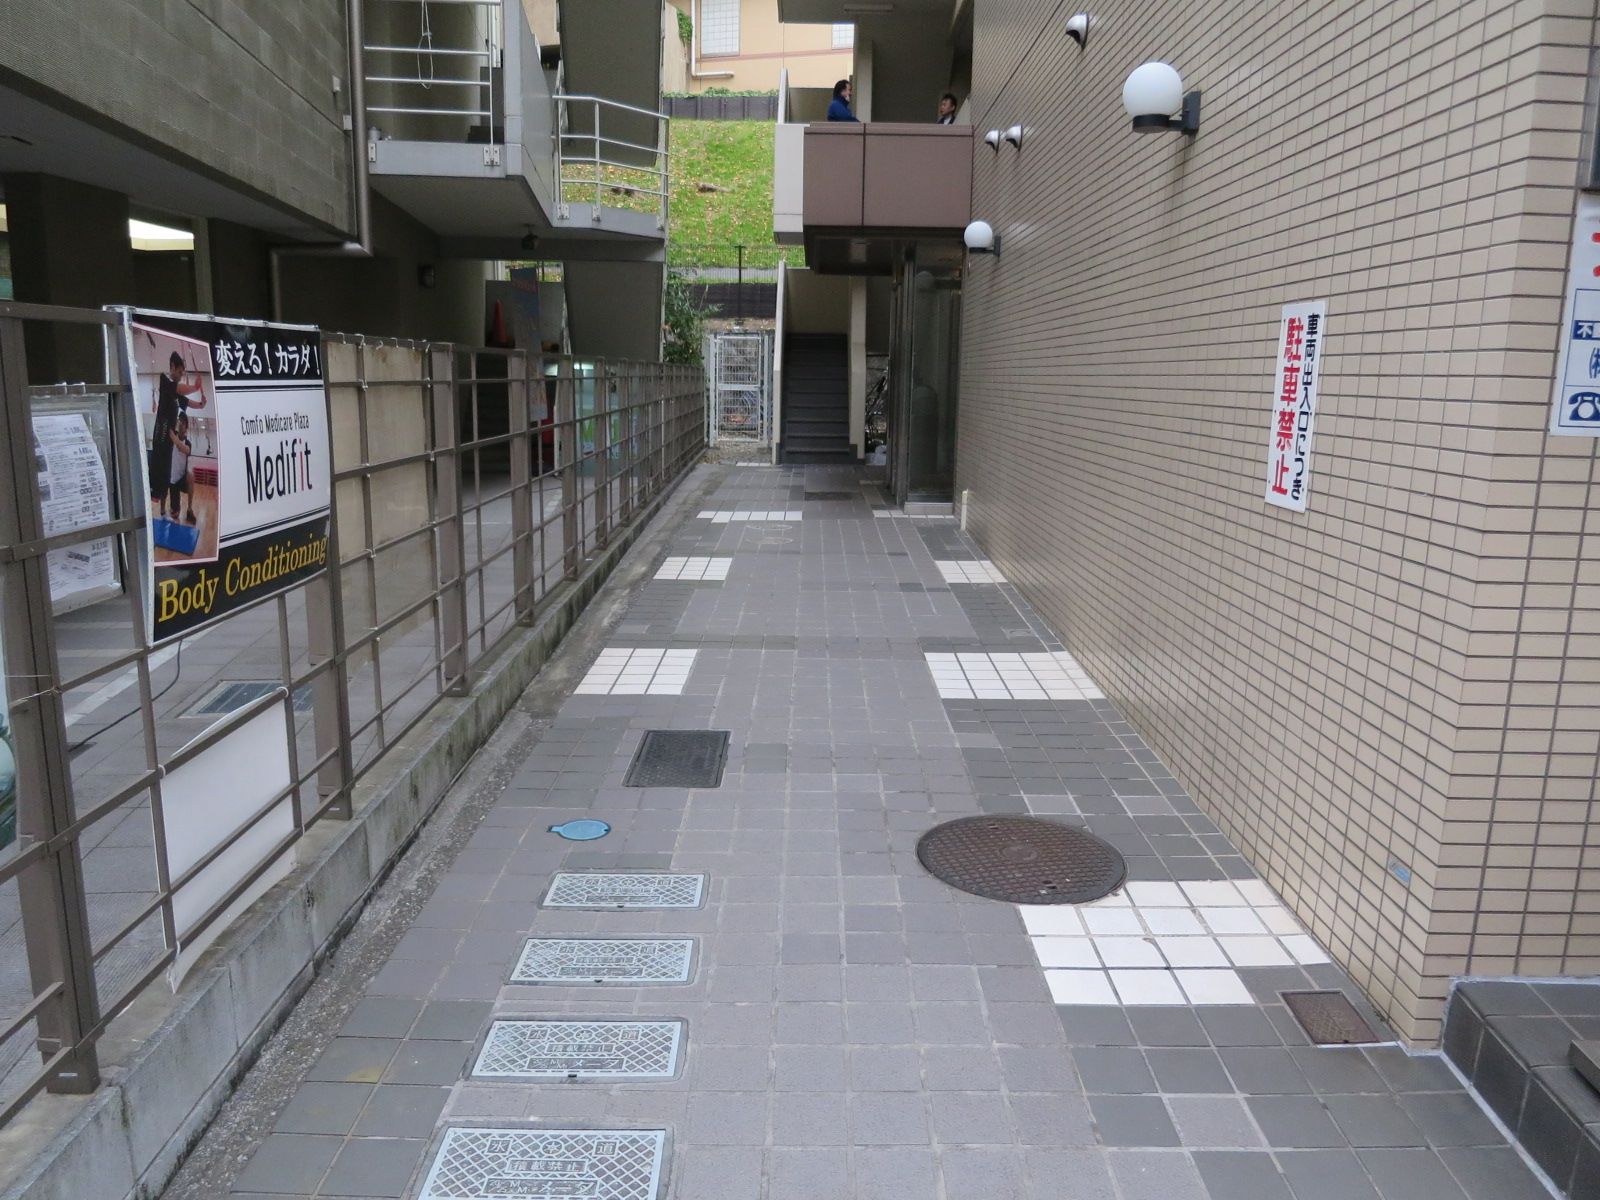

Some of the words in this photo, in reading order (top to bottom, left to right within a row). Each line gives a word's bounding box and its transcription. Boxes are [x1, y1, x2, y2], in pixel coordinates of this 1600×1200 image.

[241, 415, 264, 436] Comfo
[265, 413, 293, 433] Medicare
[294, 412, 309, 430] Plaza
[1272, 317, 1304, 495] 駐車禁止
[1291, 313, 1320, 500] 車両出入口につき
[245, 438, 313, 505] Medifit
[158, 568, 219, 623] Body
[225, 533, 327, 596] Conditioning
